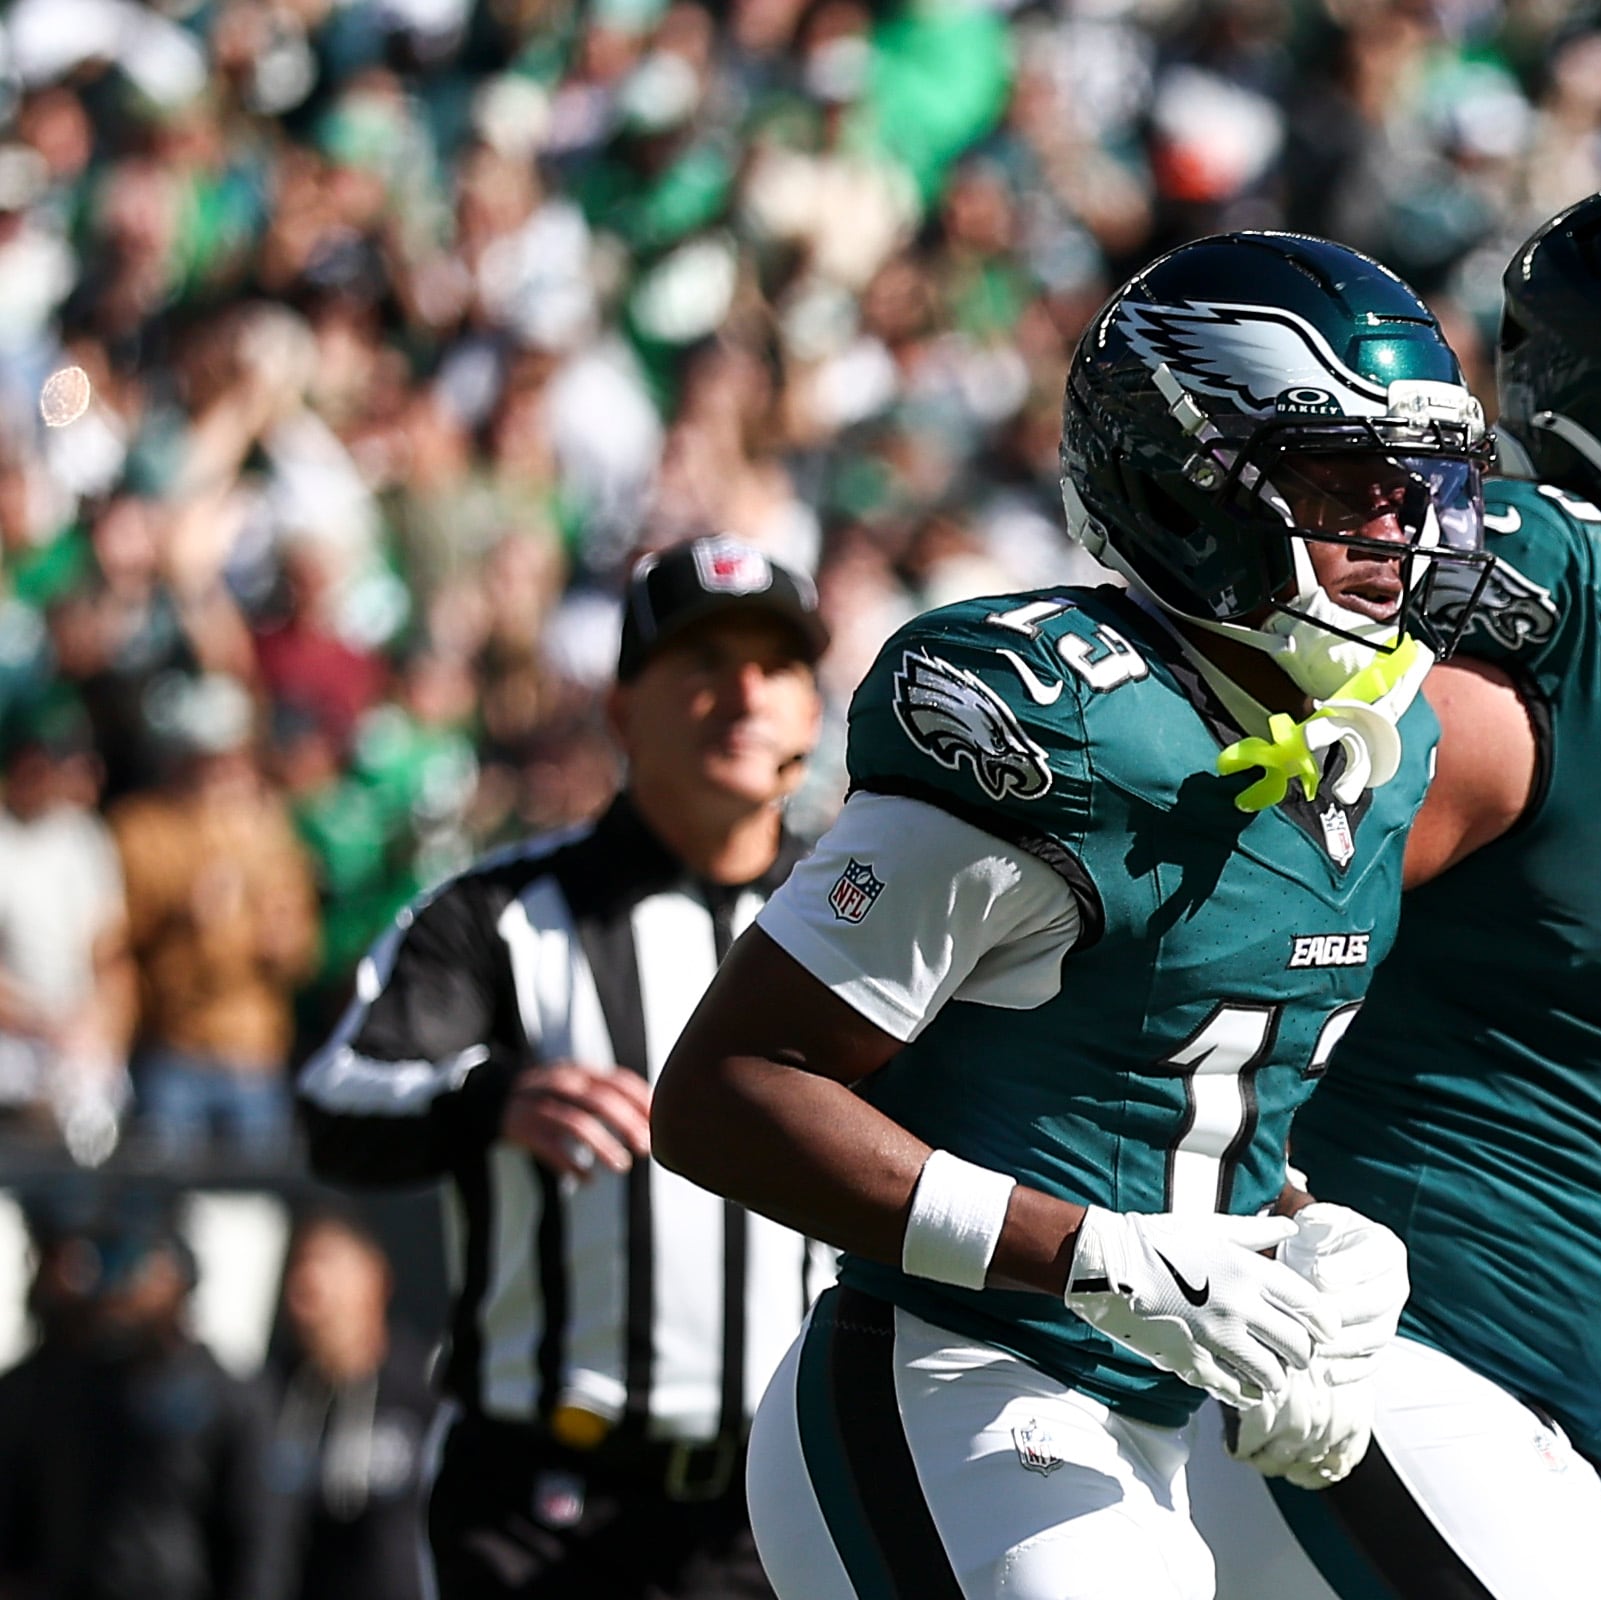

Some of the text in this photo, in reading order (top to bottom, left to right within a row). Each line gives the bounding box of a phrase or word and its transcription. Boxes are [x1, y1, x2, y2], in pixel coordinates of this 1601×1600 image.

[1276, 403, 1340, 415] OAKLEY
[832, 878, 868, 919] NFL
[1287, 934, 1370, 968] EAGLES
